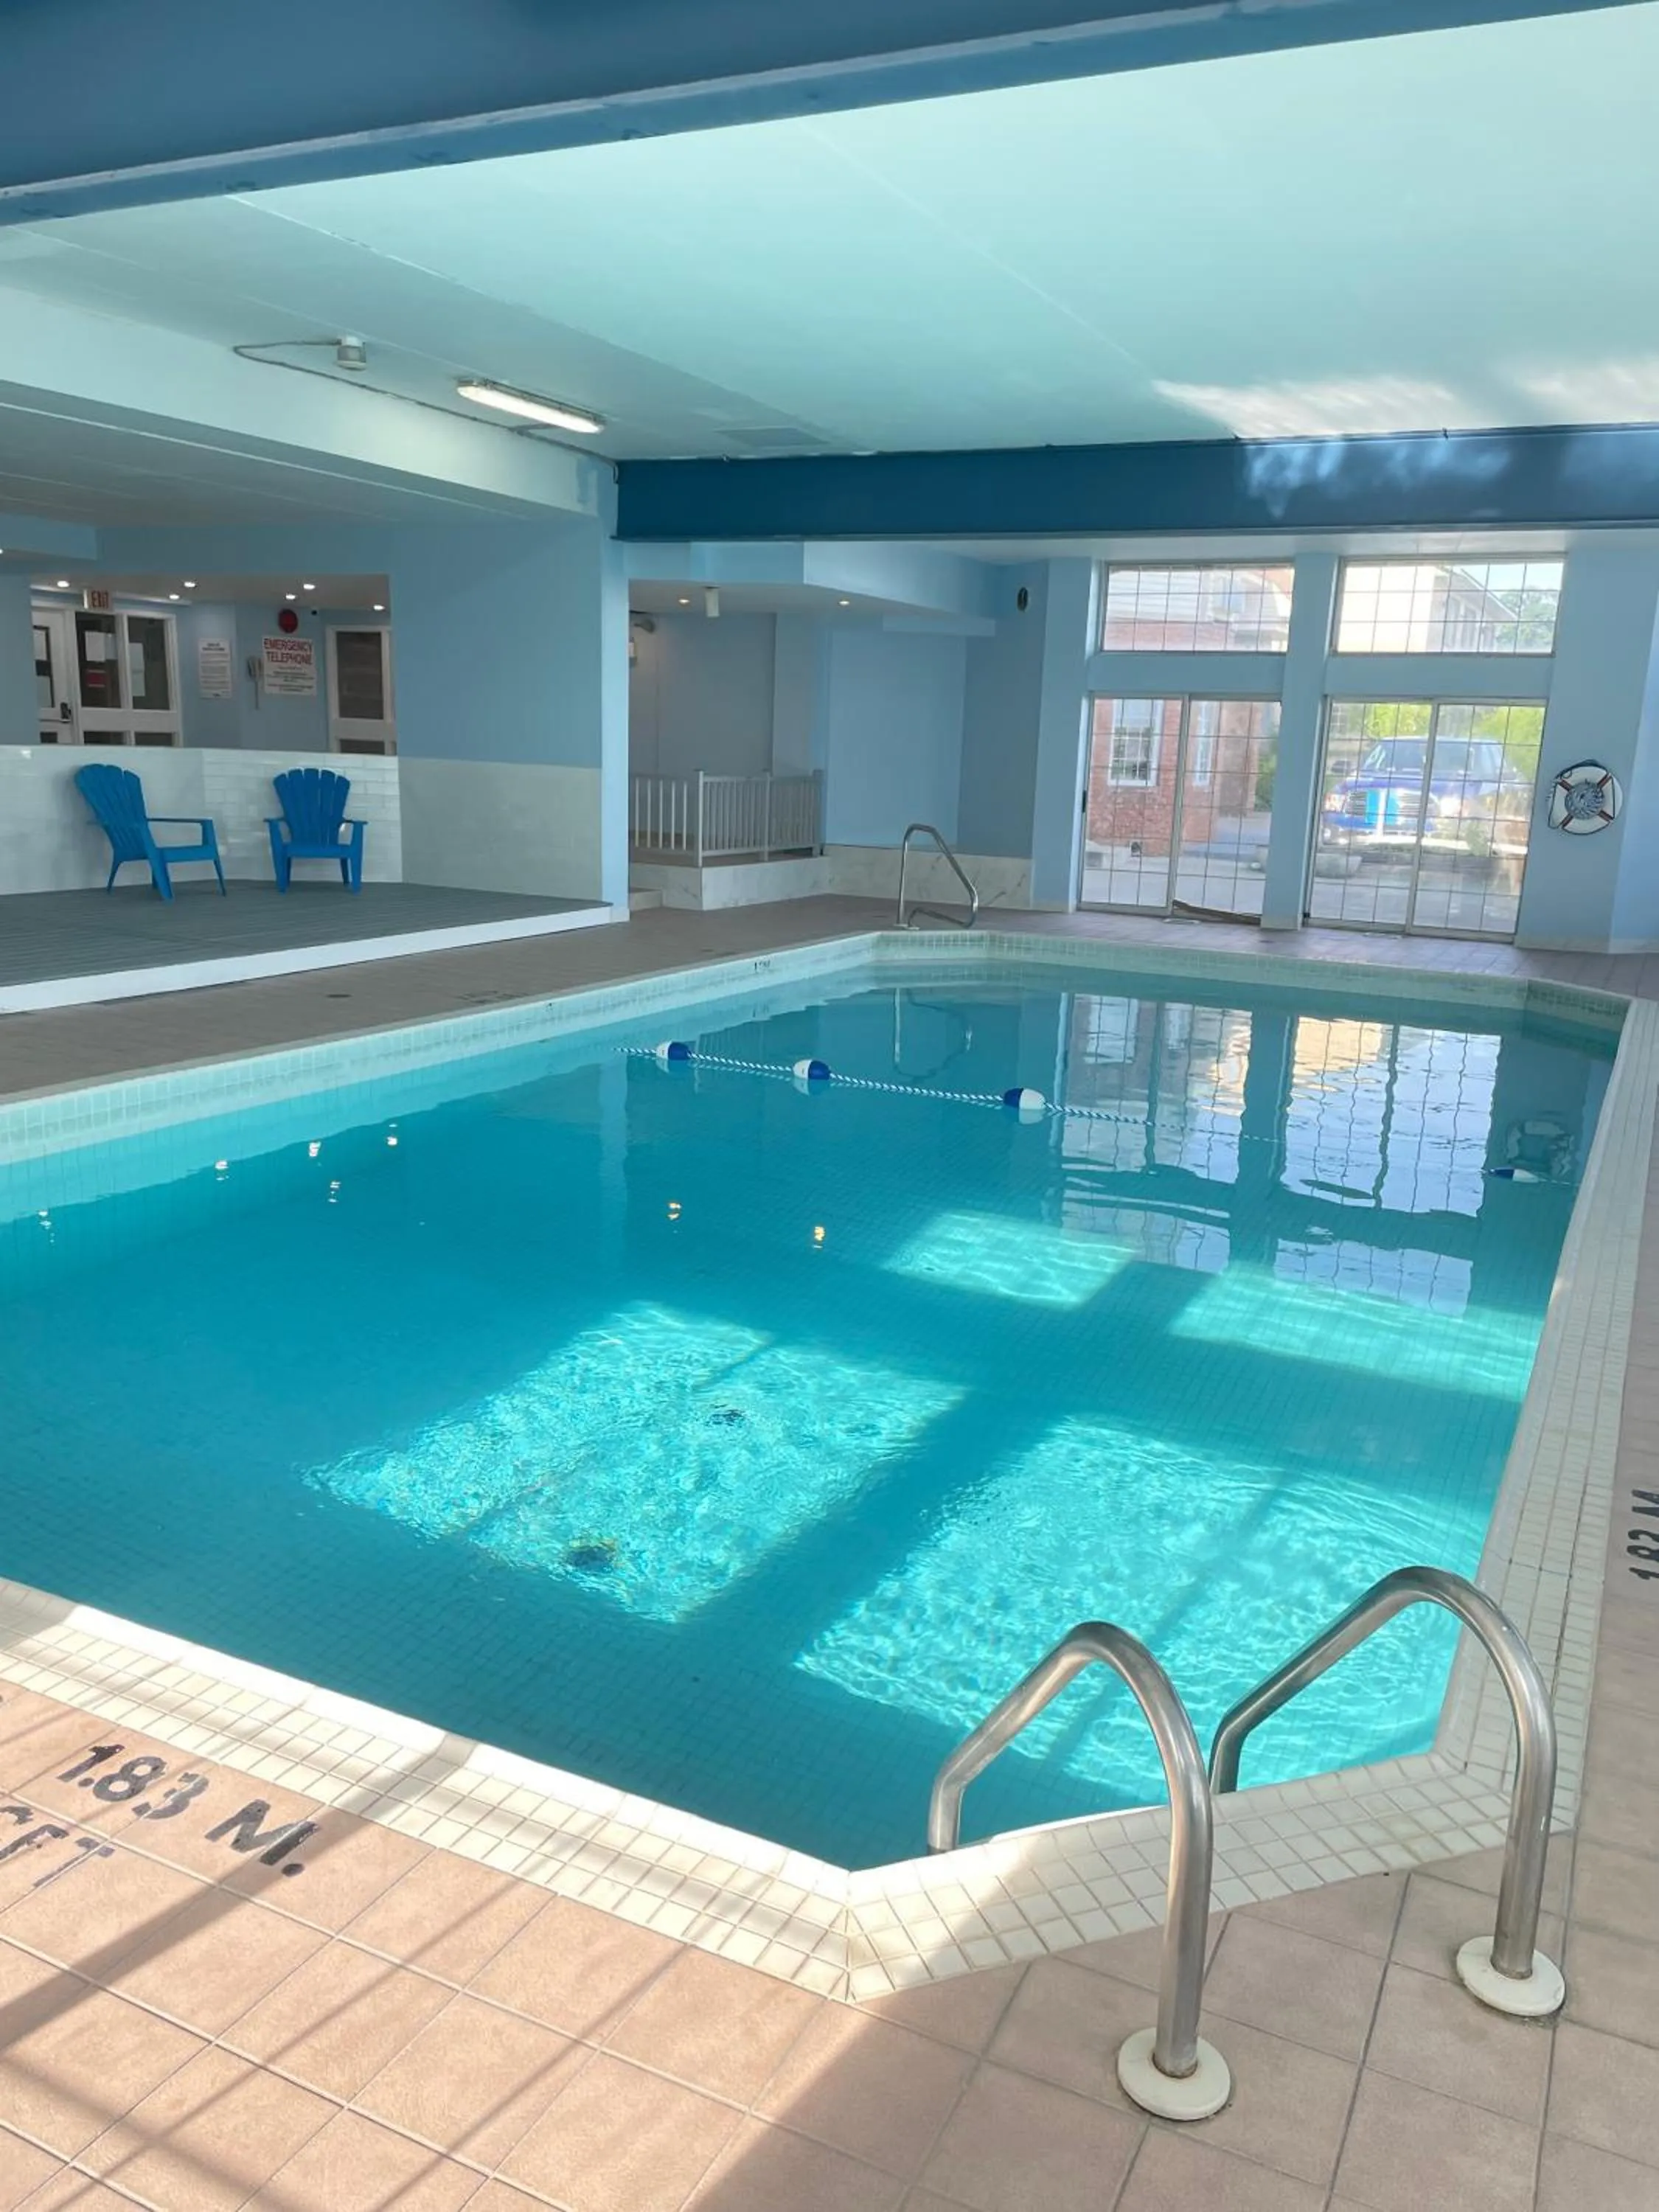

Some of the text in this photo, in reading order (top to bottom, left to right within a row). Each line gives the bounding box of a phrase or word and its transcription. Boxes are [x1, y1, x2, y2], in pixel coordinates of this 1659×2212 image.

[91, 590, 109, 608] EXIT
[263, 639, 313, 653] EMERGENCY
[265, 650, 313, 665] TELEPHONE
[57, 1743, 210, 1820] 1.83
